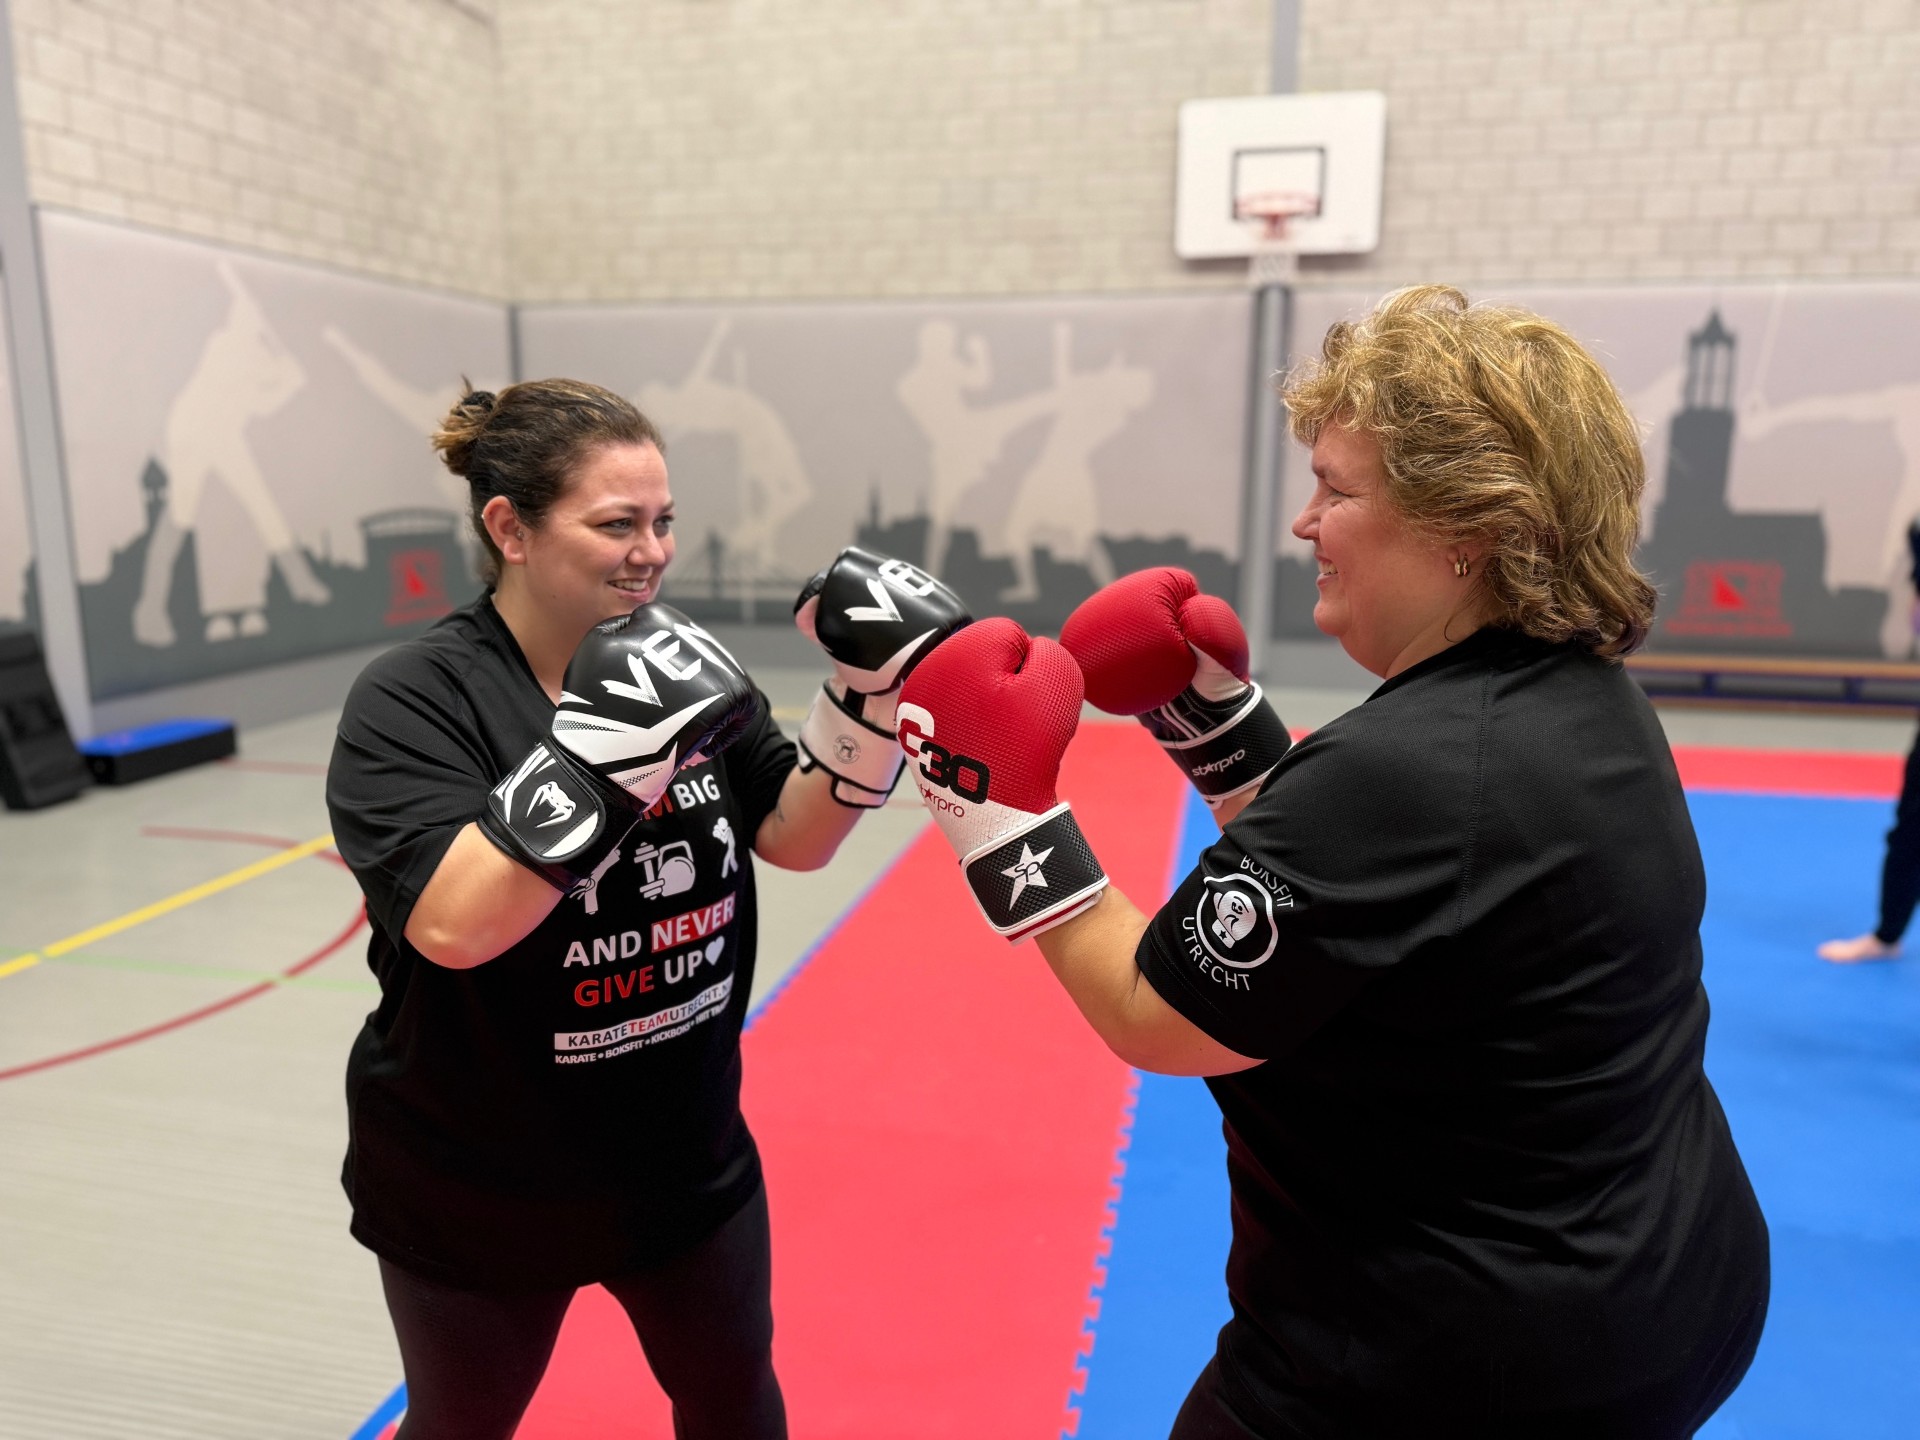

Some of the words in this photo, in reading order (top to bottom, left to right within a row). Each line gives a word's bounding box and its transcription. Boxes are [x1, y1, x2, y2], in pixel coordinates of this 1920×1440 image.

[896, 702, 990, 804] C30
[673, 774, 720, 809] BIG
[563, 931, 642, 968] AND
[652, 897, 735, 950] NEVER
[1183, 917, 1250, 991] UTRECHT
[574, 965, 655, 1007] GIVE
[664, 950, 703, 984] UP
[555, 1053, 597, 1065] KARATE
[605, 1039, 645, 1059] BOKSFIT
